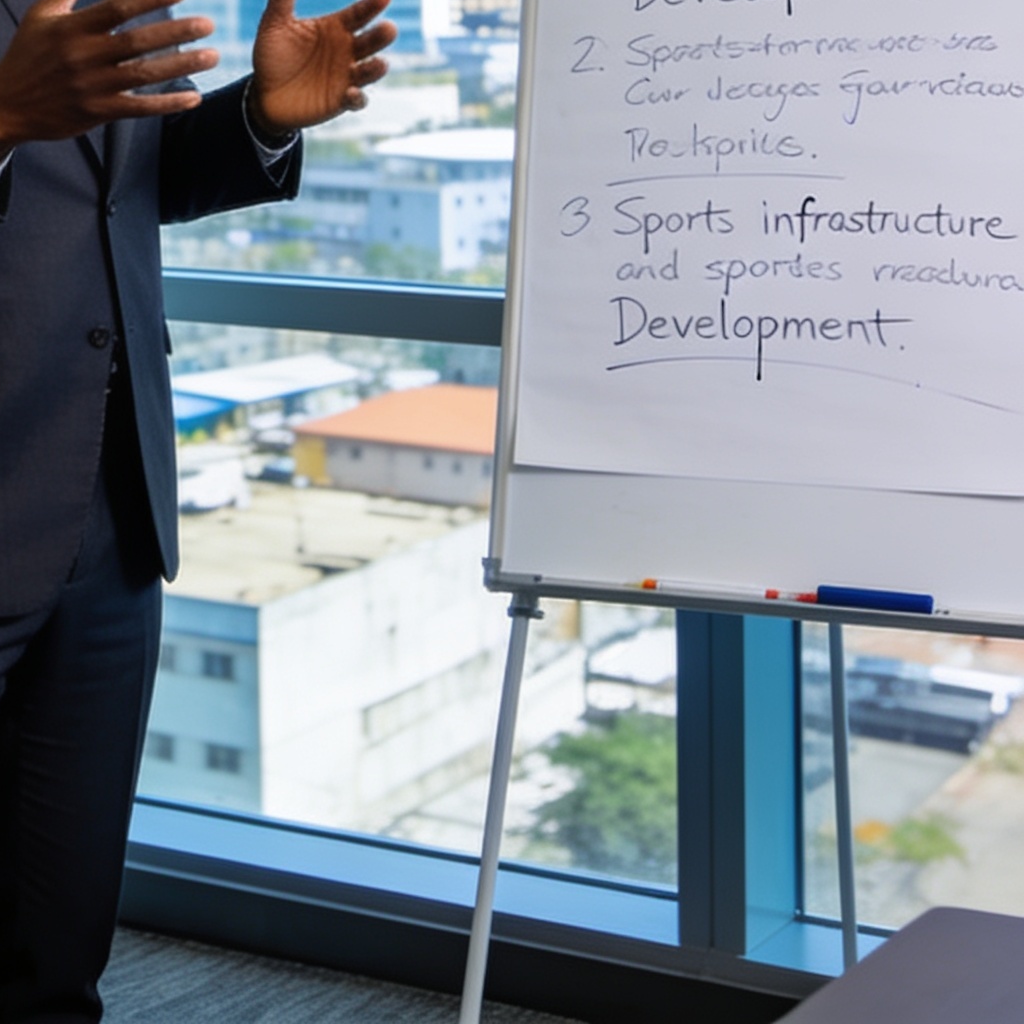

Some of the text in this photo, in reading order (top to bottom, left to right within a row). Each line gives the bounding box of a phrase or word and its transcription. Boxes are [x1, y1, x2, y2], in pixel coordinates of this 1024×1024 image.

[559, 195, 1018, 255] 3 Sports infrastructure
[615, 249, 680, 282] and
